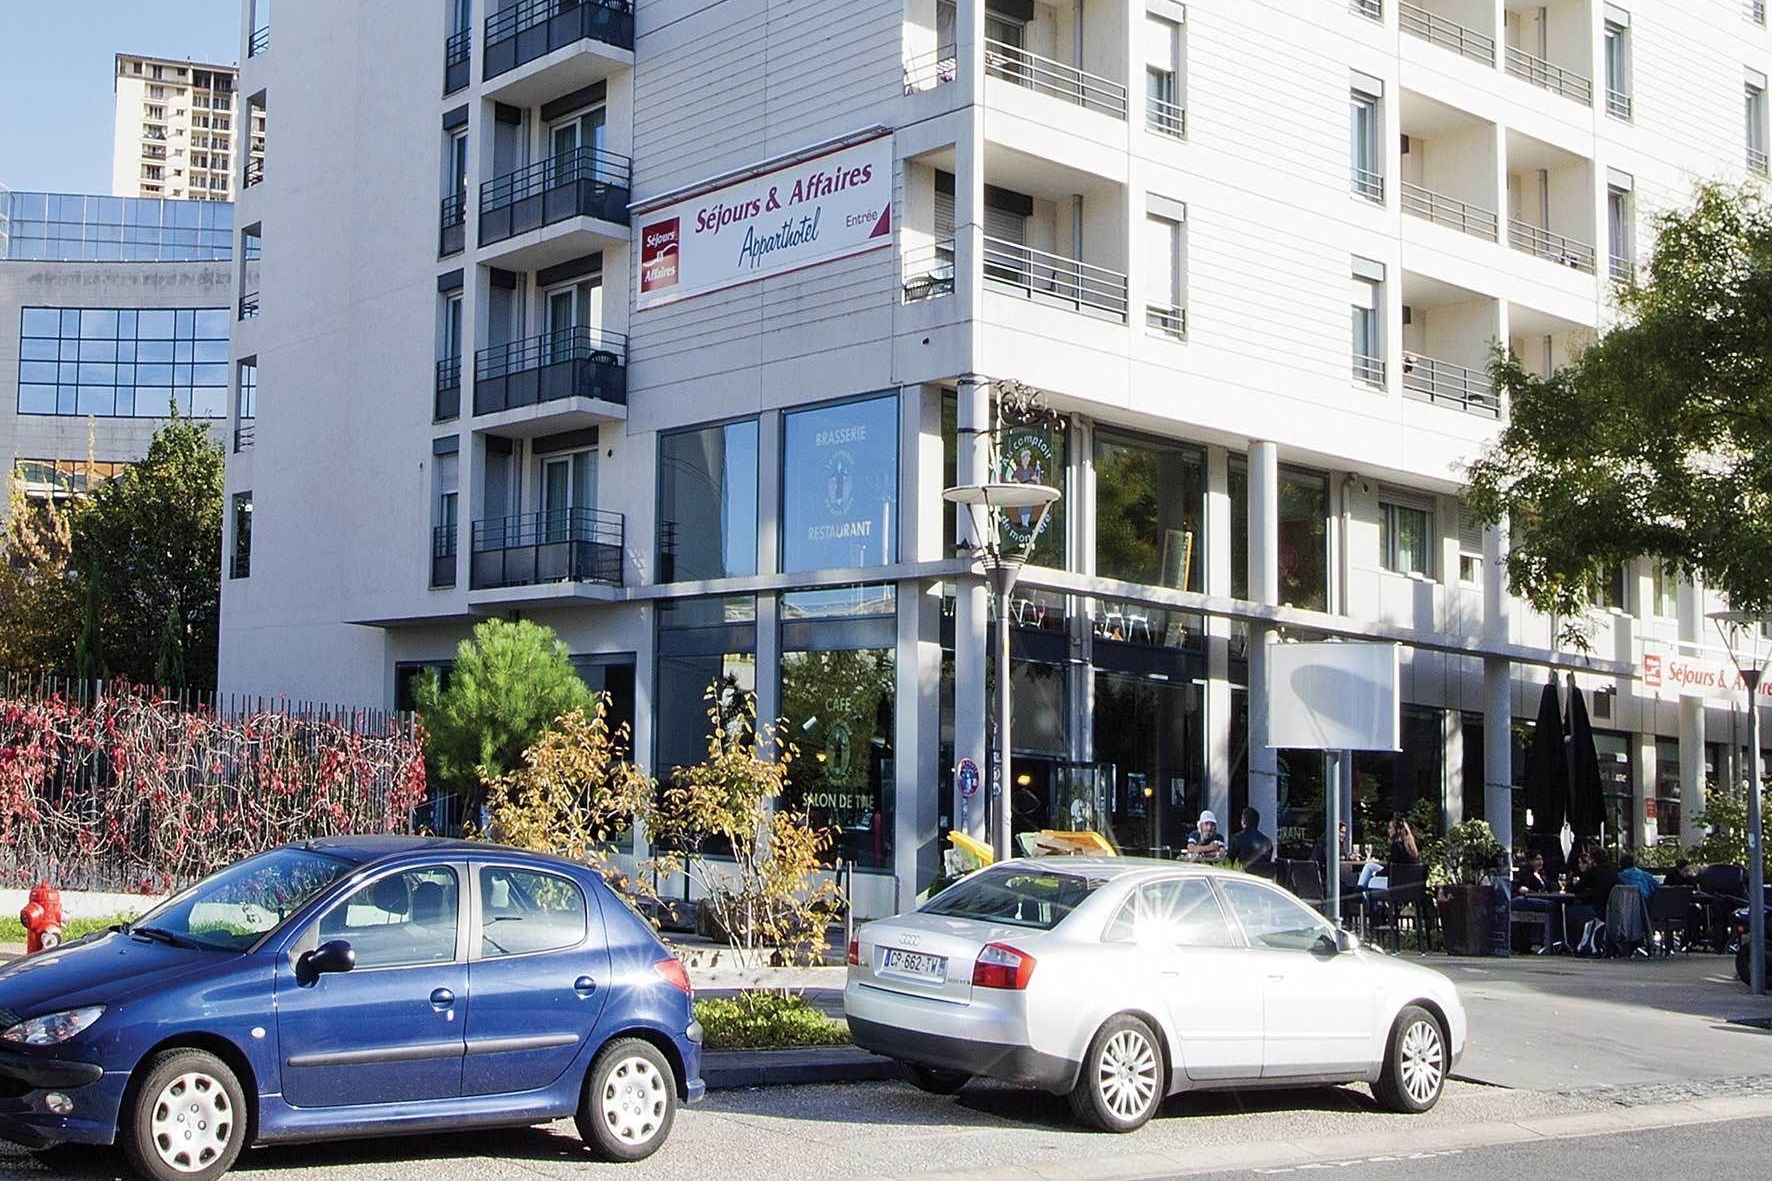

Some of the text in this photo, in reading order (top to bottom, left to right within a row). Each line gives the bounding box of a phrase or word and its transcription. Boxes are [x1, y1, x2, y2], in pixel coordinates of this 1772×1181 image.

[695, 163, 873, 235] Séjours & Affaires
[845, 210, 879, 228] Entrée
[646, 230, 676, 248] Séjours
[738, 206, 822, 270] Apparthotel
[644, 265, 676, 283] Affaires
[815, 425, 867, 447] BRASSERIE
[1013, 434, 1052, 460] comptoir
[807, 521, 872, 540] RESTAURANT
[1667, 661, 1715, 689] Séjours
[1717, 670, 1728, 689] &
[840, 793, 853, 808] DE
